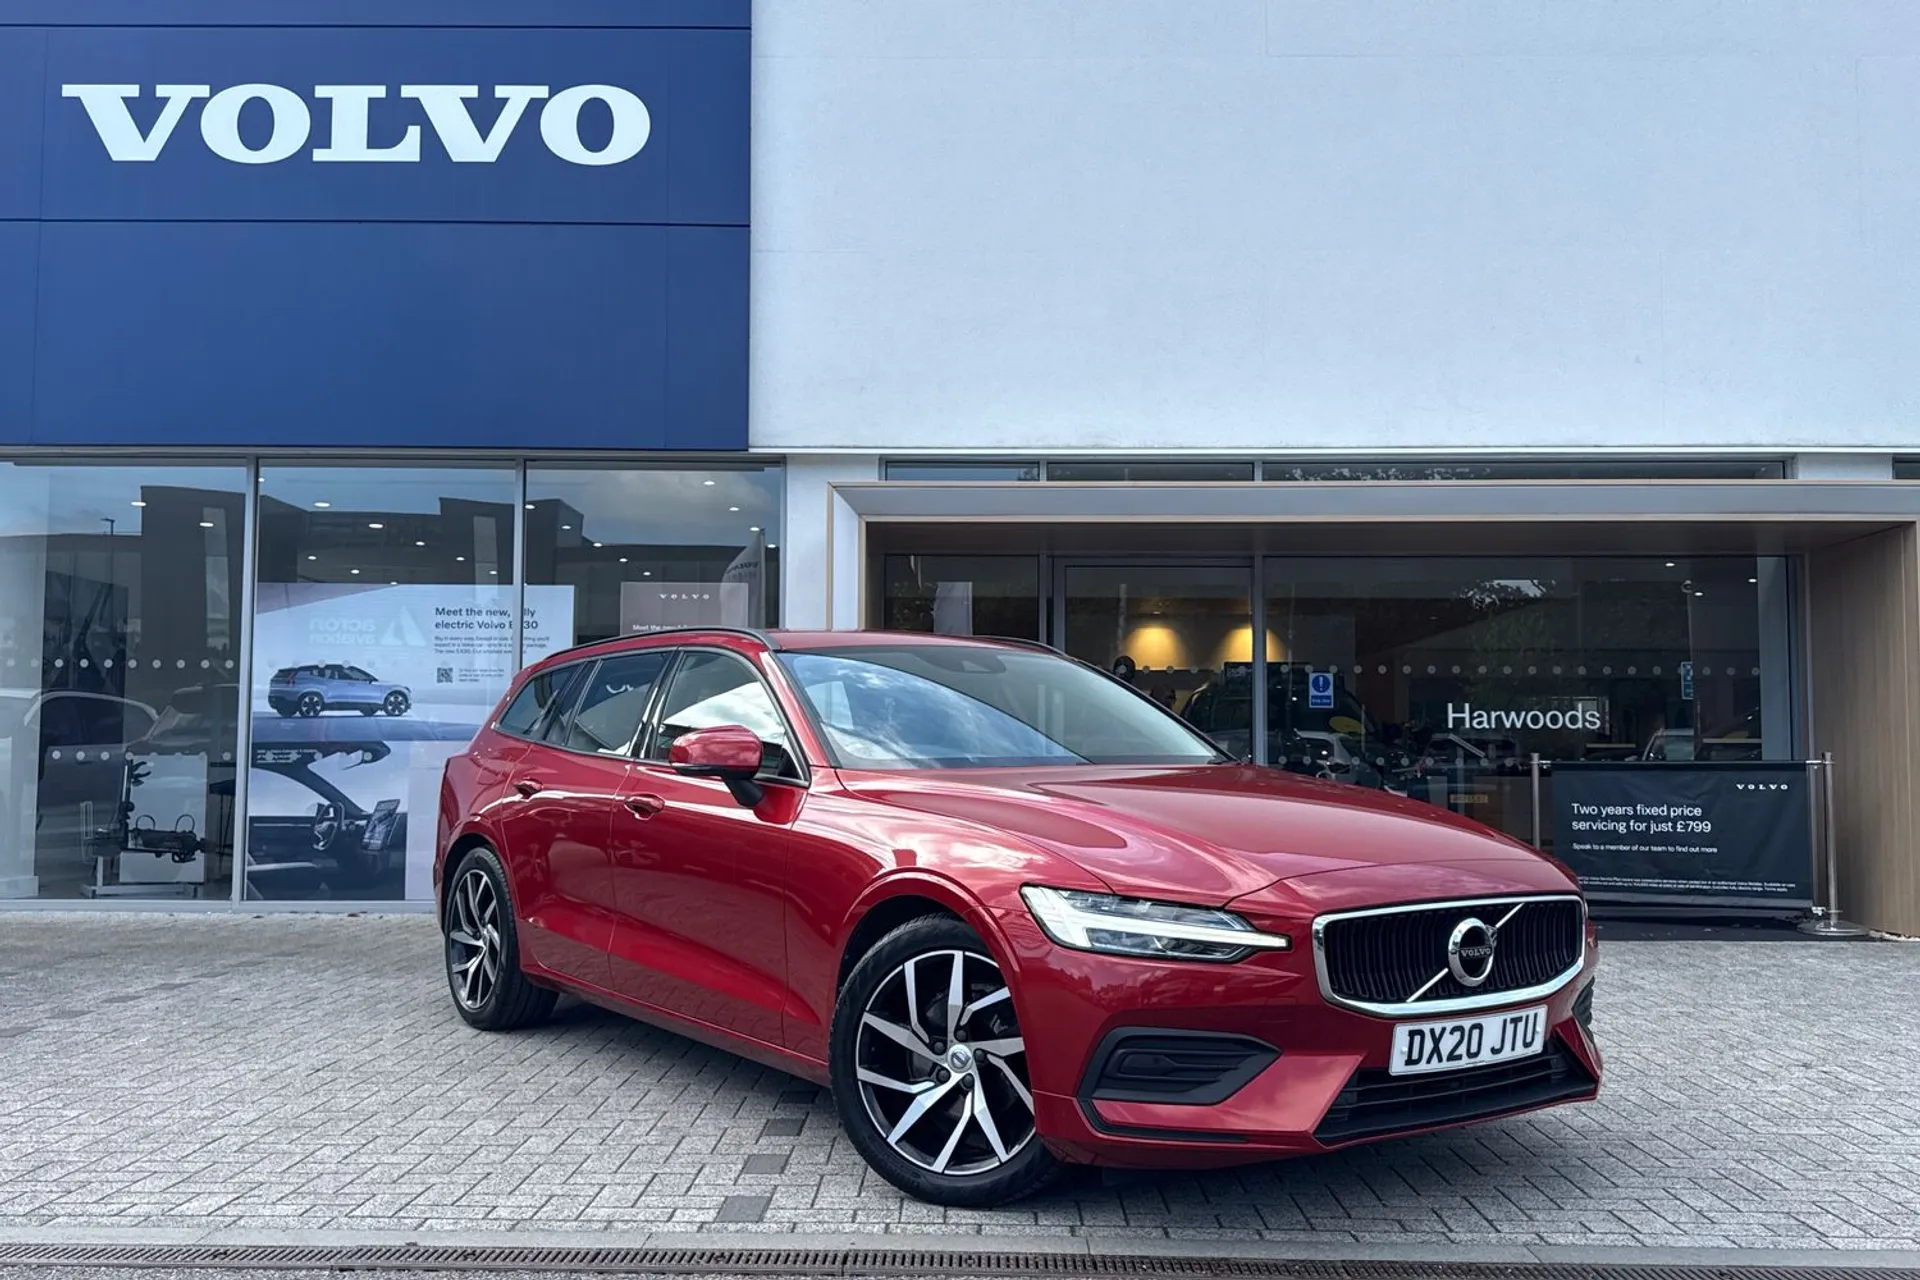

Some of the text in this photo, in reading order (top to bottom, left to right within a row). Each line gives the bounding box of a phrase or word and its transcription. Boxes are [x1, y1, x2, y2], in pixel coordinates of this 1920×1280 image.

[62, 83, 651, 166] VOLVO
[435, 607, 463, 616] Meet
[466, 608, 483, 616] the
[485, 609, 511, 618] new,
[434, 620, 539, 630] electric Volvo E30
[1447, 702, 1601, 730] Harwoods
[1571, 803, 1702, 819] Two years fixed price
[1571, 820, 1712, 835] servicing for just £799
[1572, 842, 1592, 851] Speak
[1605, 843, 1631, 851] member
[1676, 845, 1689, 853] find
[1460, 947, 1491, 957] VOLVO
[1404, 1012, 1539, 1066] DX20 JTU
